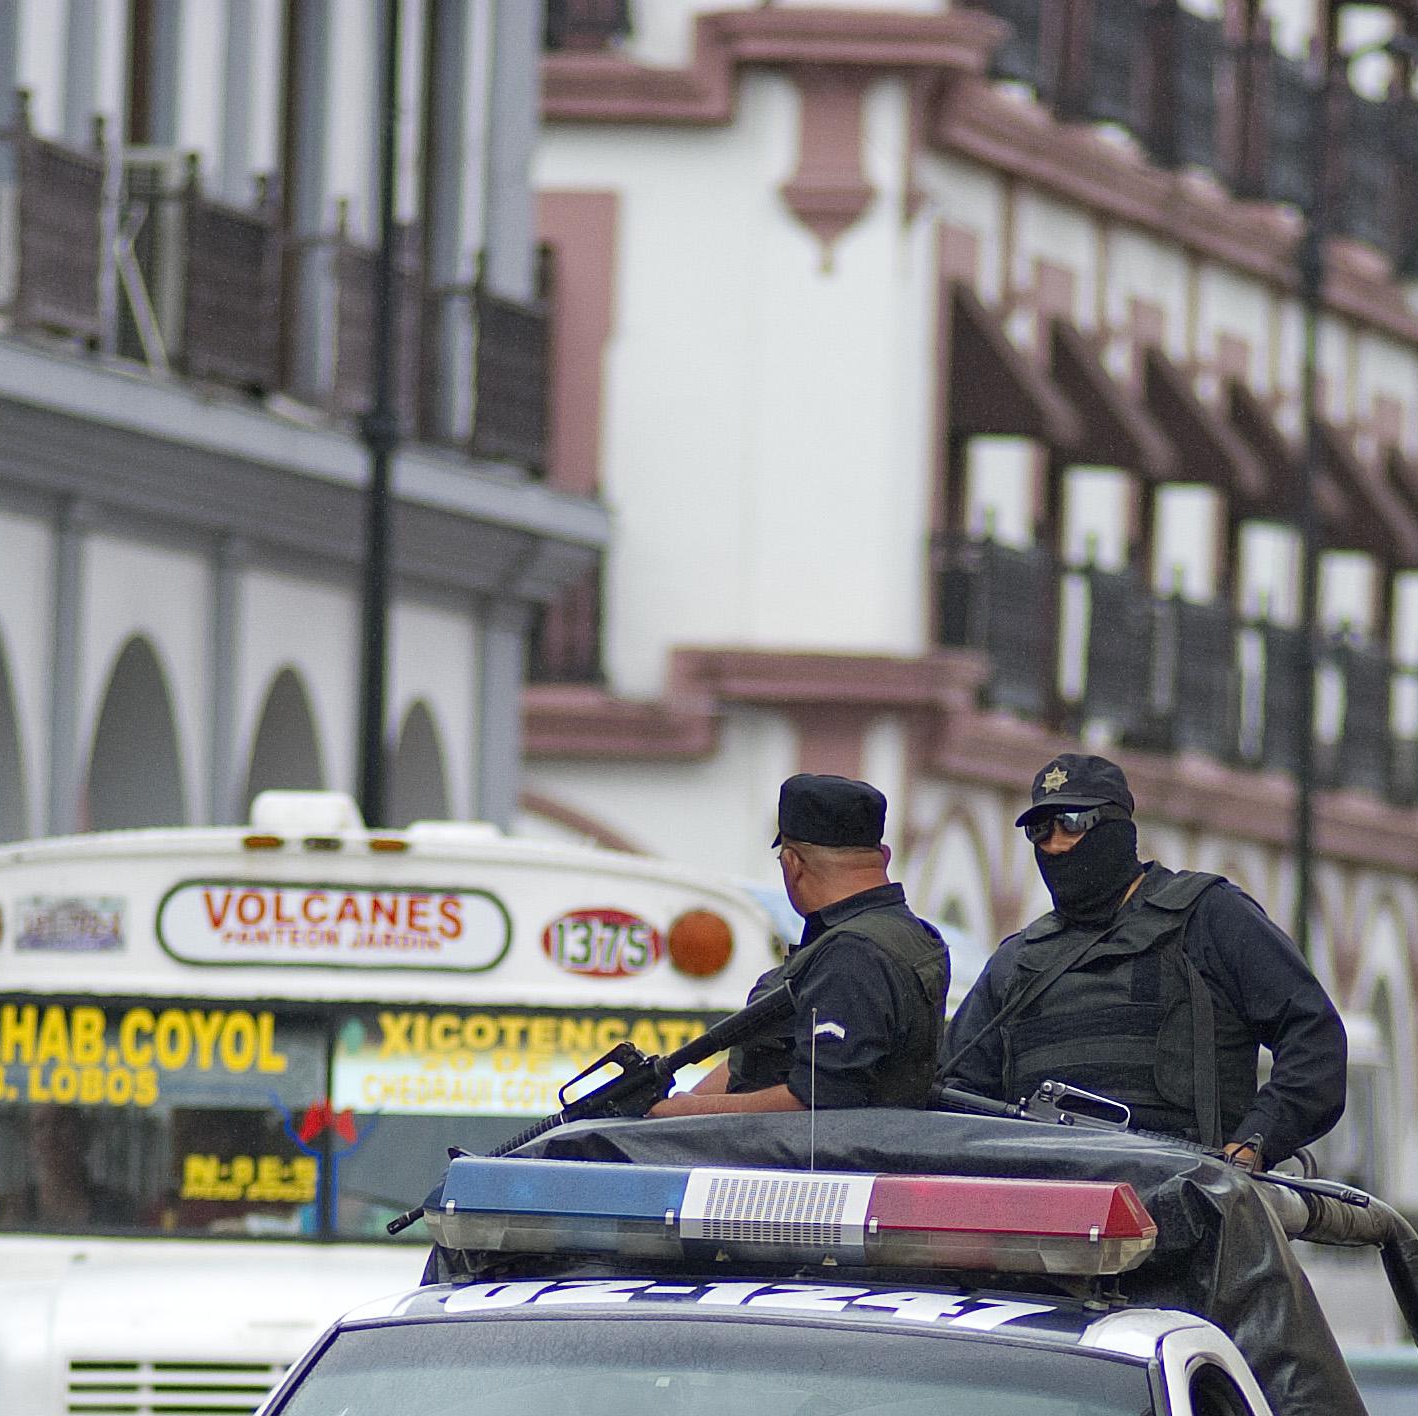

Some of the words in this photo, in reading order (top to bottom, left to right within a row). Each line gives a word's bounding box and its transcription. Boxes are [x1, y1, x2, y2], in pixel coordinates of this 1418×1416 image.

[202, 886, 464, 942] VOLCANES
[554, 918, 650, 968] 1375
[28, 1065, 159, 1107] LOBOS
[444, 1280, 1059, 1331] 02-1247
